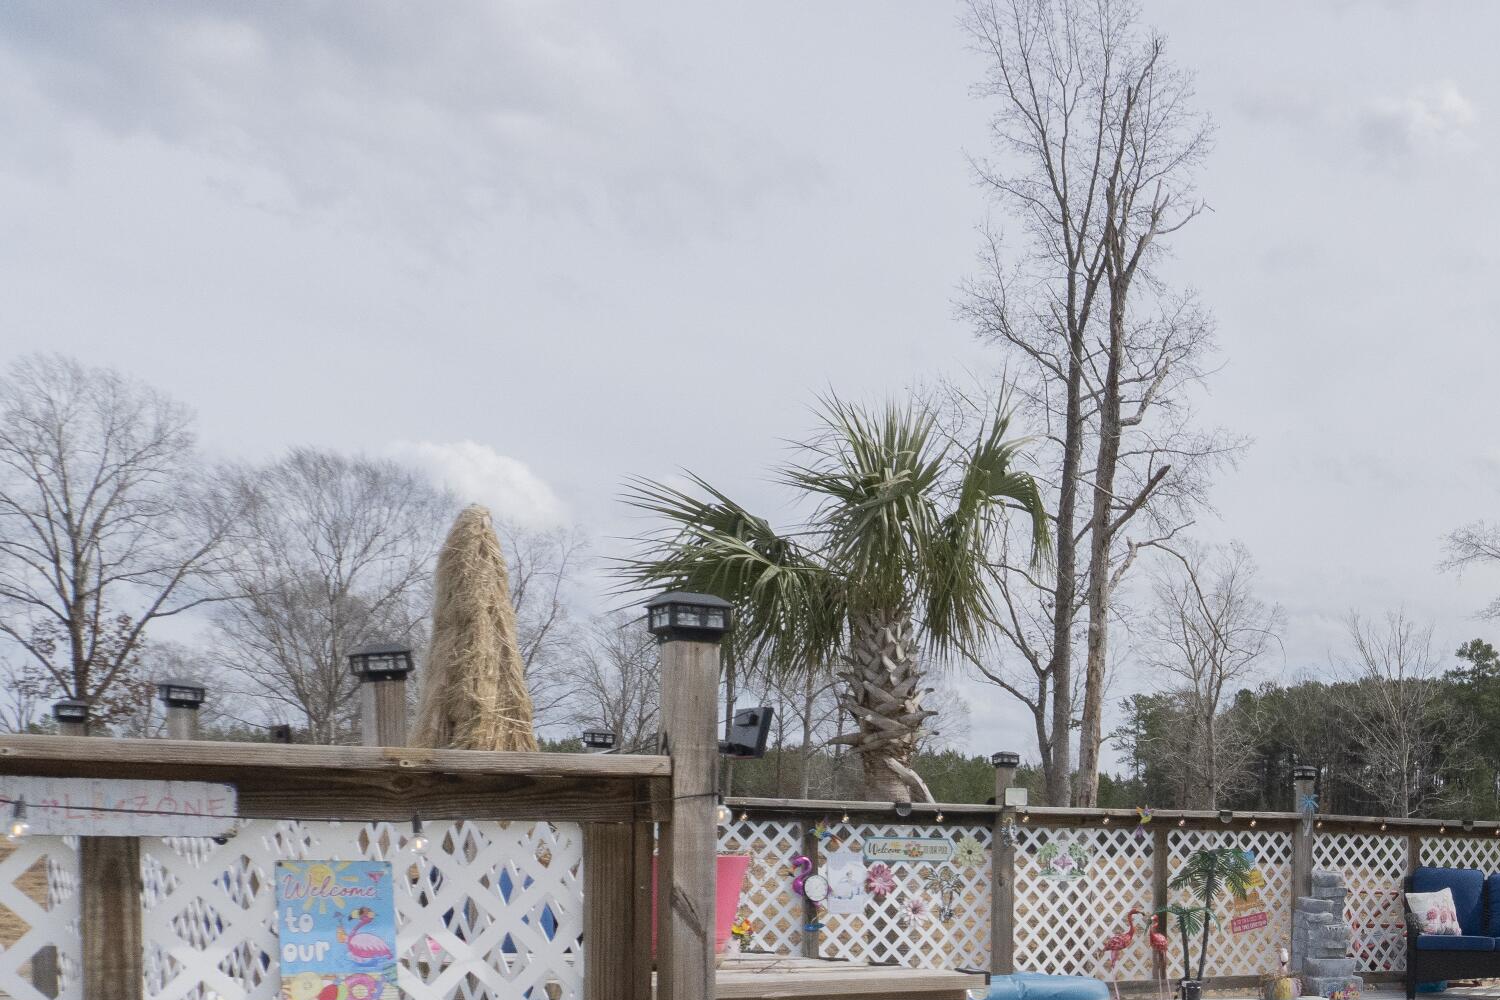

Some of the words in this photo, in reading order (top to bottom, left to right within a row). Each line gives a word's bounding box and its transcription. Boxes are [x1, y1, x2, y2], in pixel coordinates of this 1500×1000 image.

[868, 842, 901, 856] Welcome
[282, 873, 377, 900] Welcome
[285, 906, 314, 933] to
[283, 941, 331, 963] our
